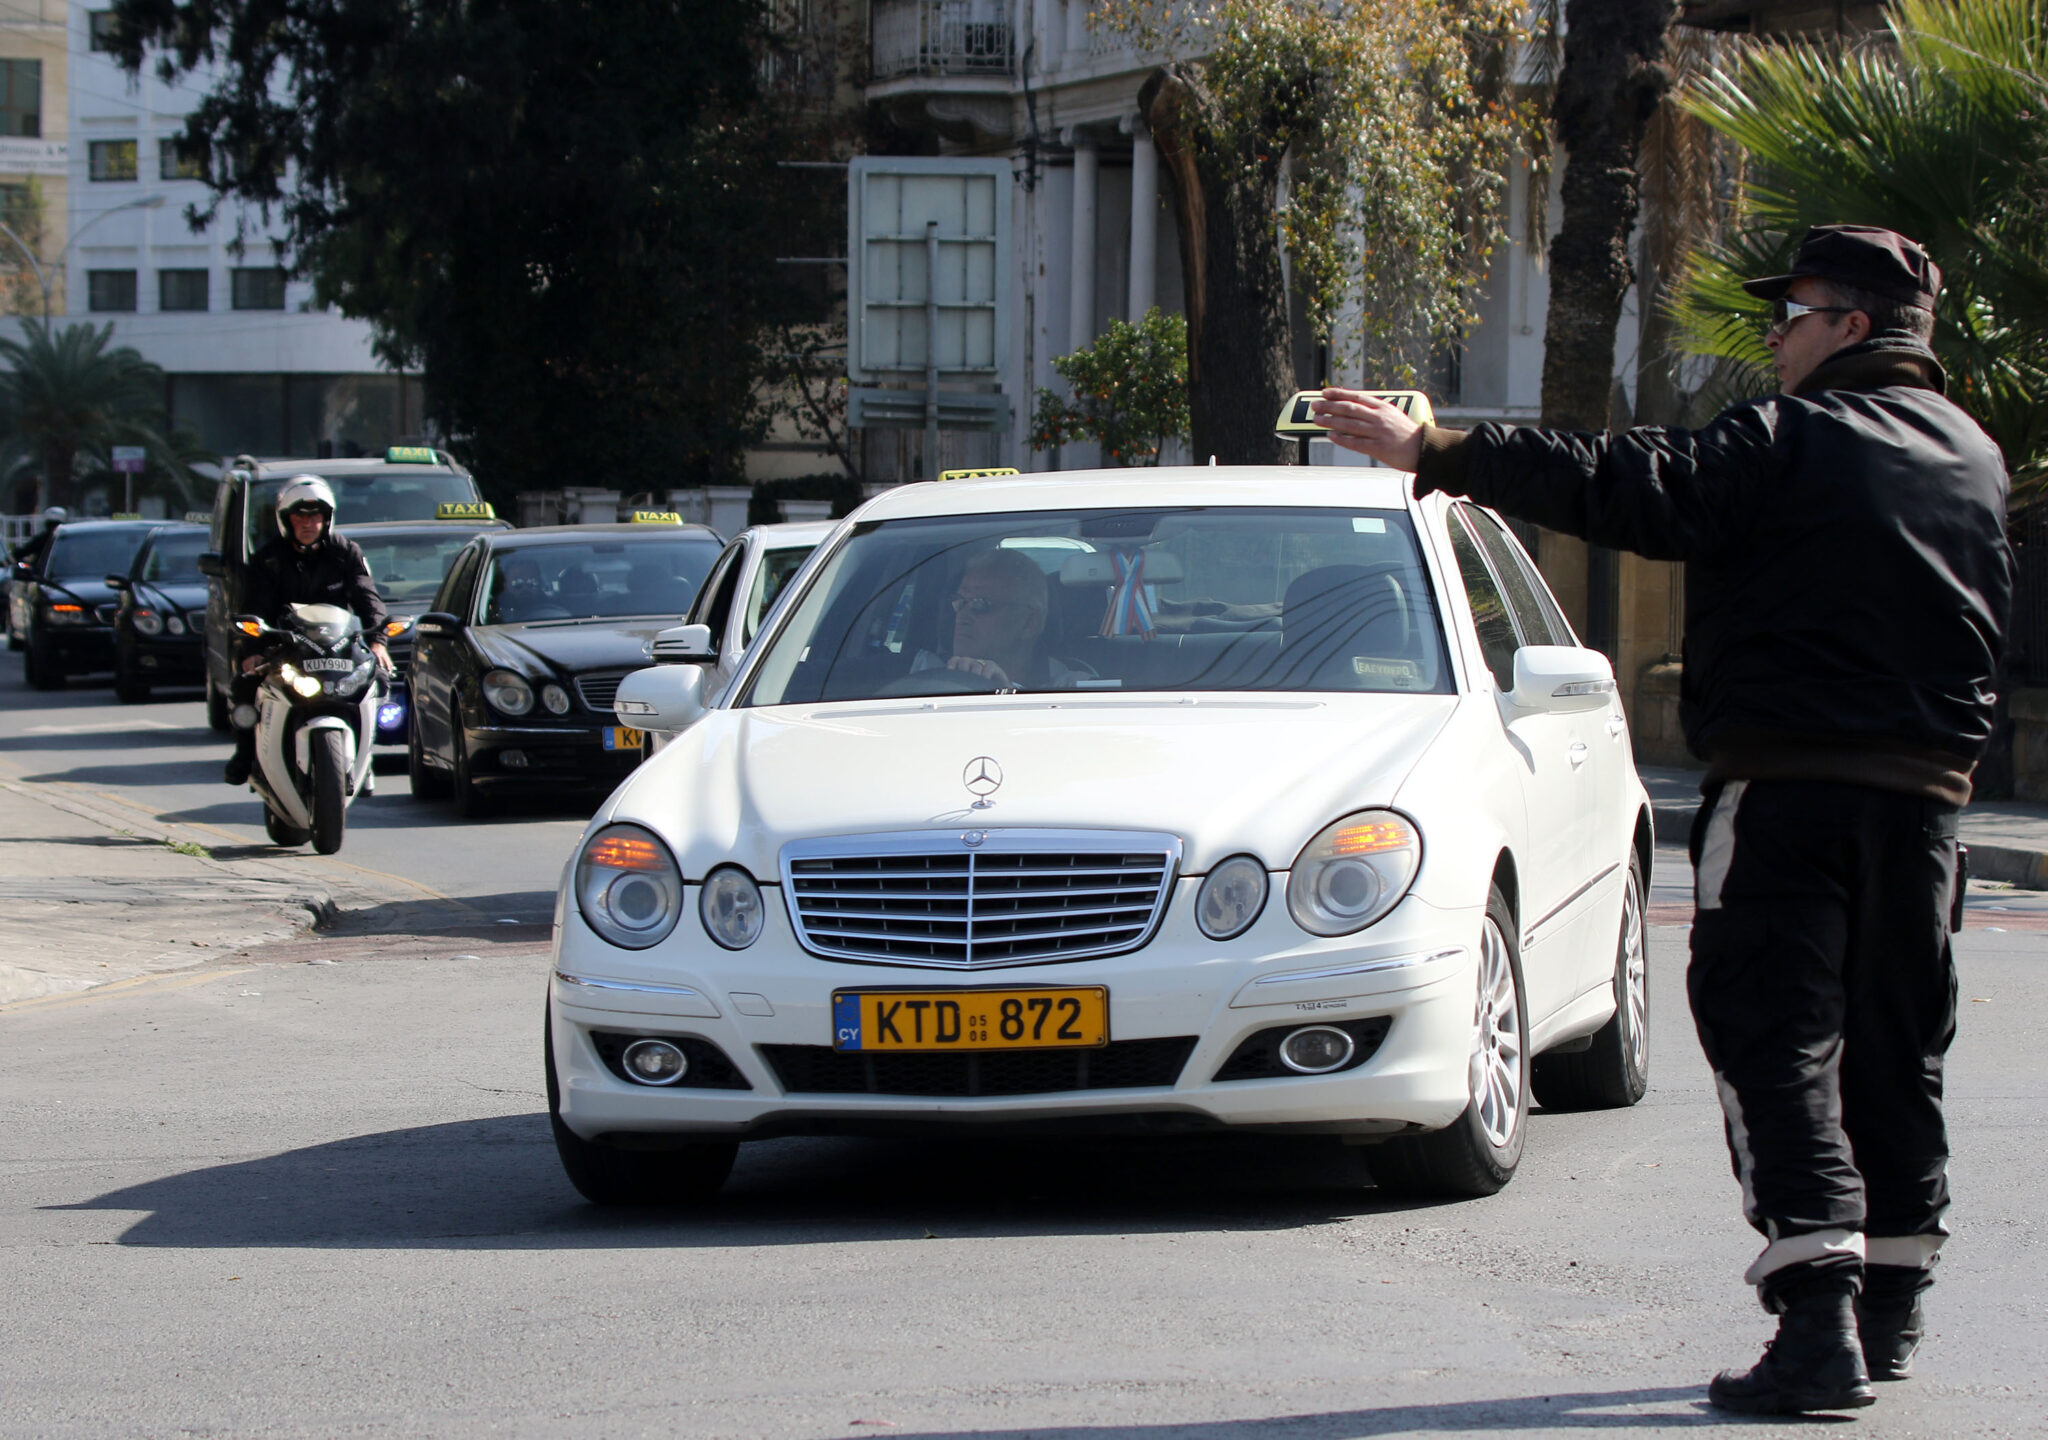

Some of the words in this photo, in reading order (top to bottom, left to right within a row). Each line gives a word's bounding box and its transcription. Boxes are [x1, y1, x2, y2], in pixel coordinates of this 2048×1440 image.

[391, 446, 429, 457] TAXI
[443, 503, 485, 514] TAXI
[640, 511, 675, 520] TAXI
[306, 660, 347, 672] KUY990
[876, 1000, 961, 1043] KTD
[1000, 998, 1082, 1041] 872
[969, 1015, 987, 1027] 05
[838, 1028, 858, 1041] CY
[969, 1030, 987, 1042] 08
